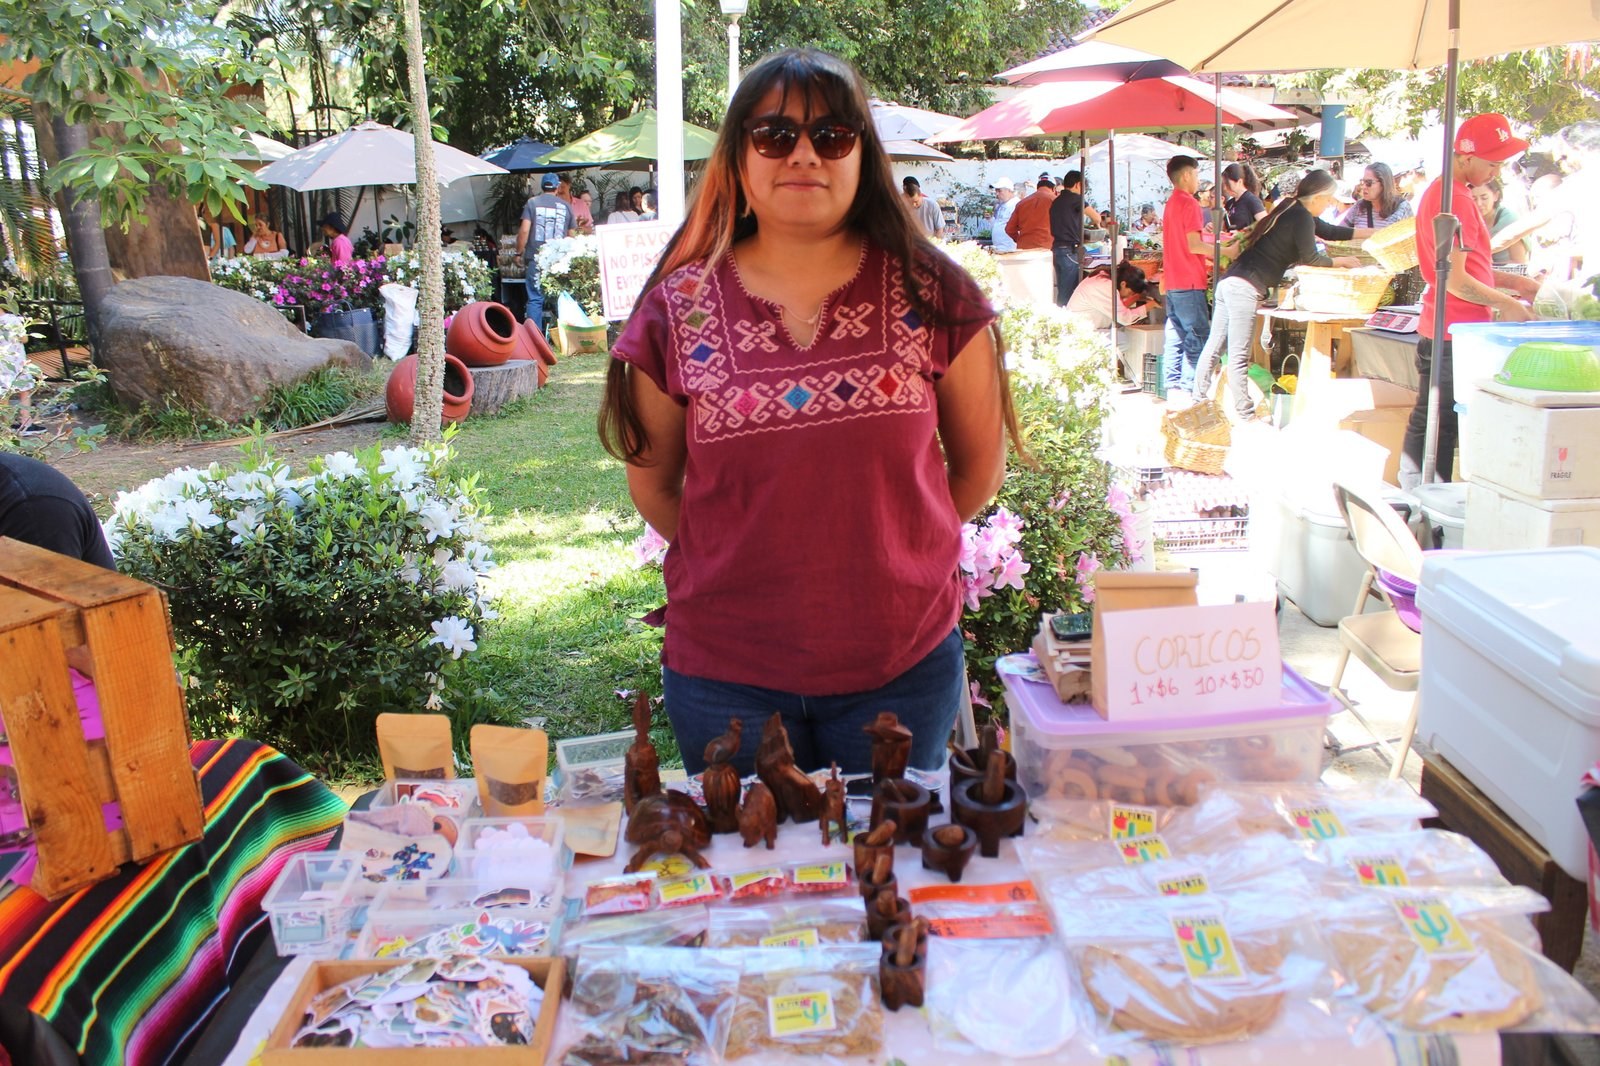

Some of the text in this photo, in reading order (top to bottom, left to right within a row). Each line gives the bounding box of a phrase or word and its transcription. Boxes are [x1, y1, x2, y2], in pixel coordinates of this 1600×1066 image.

[1495, 128, 1509, 142] LA
[610, 254, 628, 270] NO
[1134, 628, 1261, 675] CORICOS
